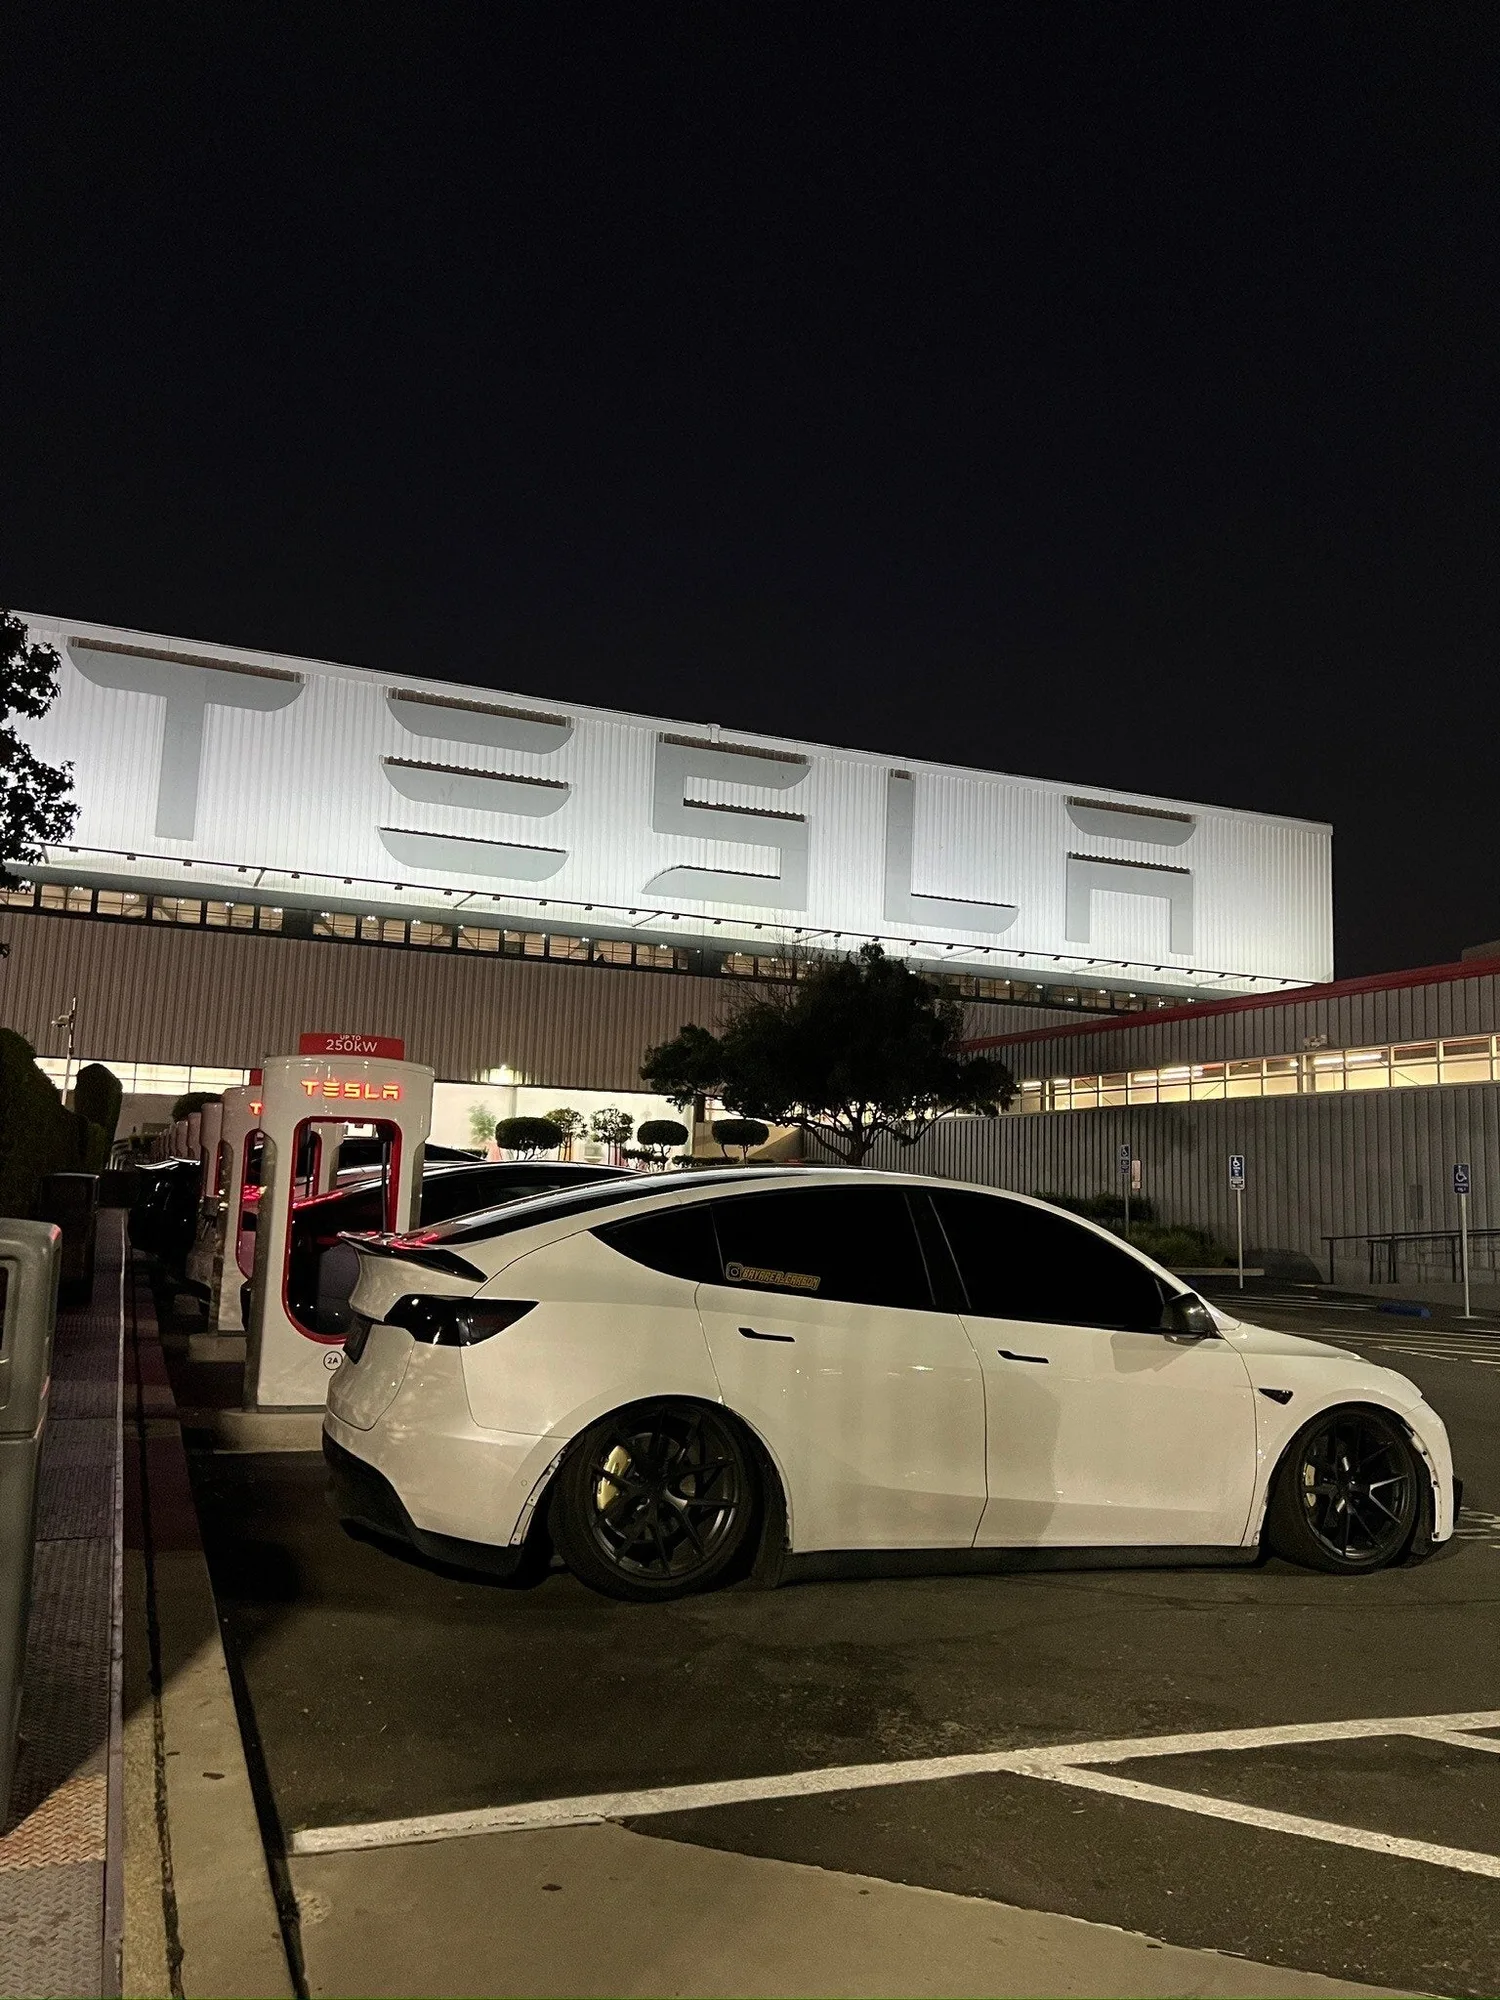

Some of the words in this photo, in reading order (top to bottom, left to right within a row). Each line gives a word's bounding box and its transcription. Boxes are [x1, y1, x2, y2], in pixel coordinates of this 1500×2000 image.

[67, 636, 1196, 954] TESLA
[326, 1039, 377, 1053] 250kW
[301, 1080, 400, 1101] TESLA
